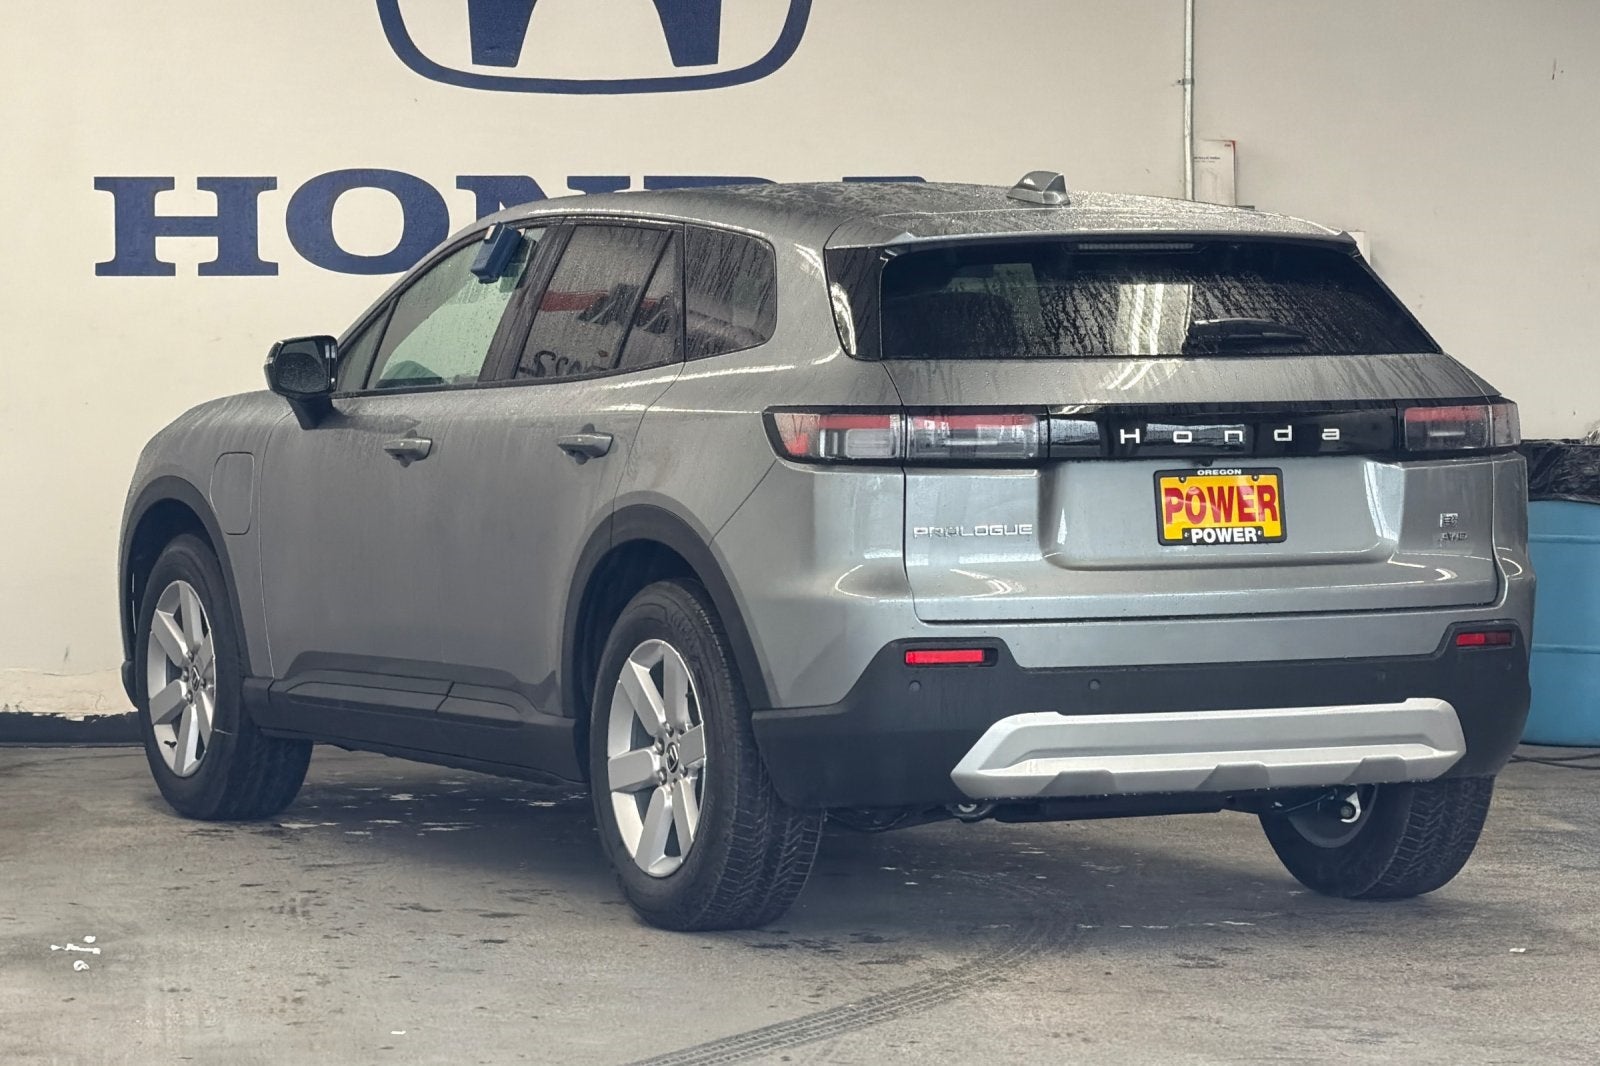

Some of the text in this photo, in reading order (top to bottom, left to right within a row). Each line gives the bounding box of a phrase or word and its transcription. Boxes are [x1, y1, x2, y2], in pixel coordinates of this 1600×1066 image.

[1119, 424, 1340, 445] Honda
[1197, 468, 1242, 476] OREGON
[1163, 484, 1279, 525] POWER
[913, 523, 1033, 539] PROLOGUE
[1191, 527, 1258, 544] POWER
